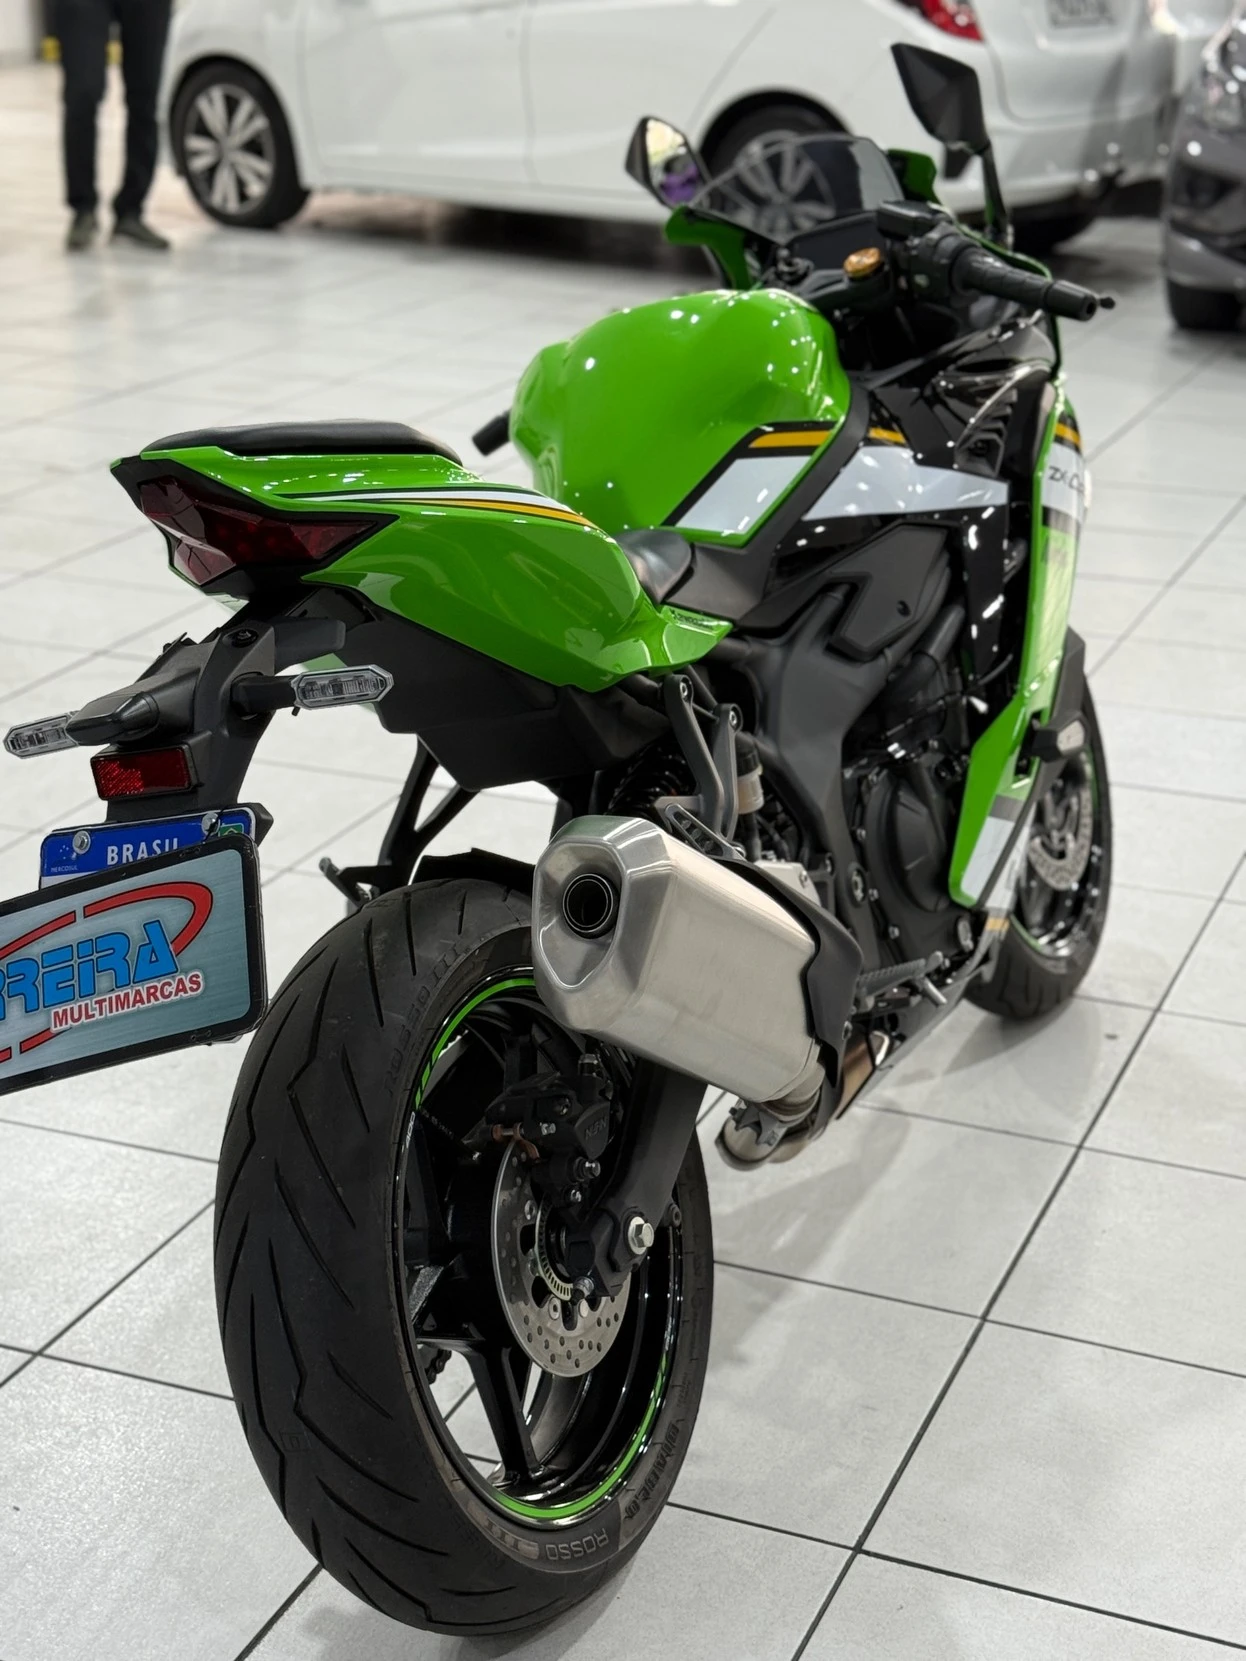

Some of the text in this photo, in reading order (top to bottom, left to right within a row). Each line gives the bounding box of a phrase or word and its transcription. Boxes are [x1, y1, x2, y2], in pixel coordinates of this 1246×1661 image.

[0, 920, 178, 1020] REIRA
[53, 974, 201, 1028] MULTIMARCAS
[546, 1528, 609, 1560] ROSSO
